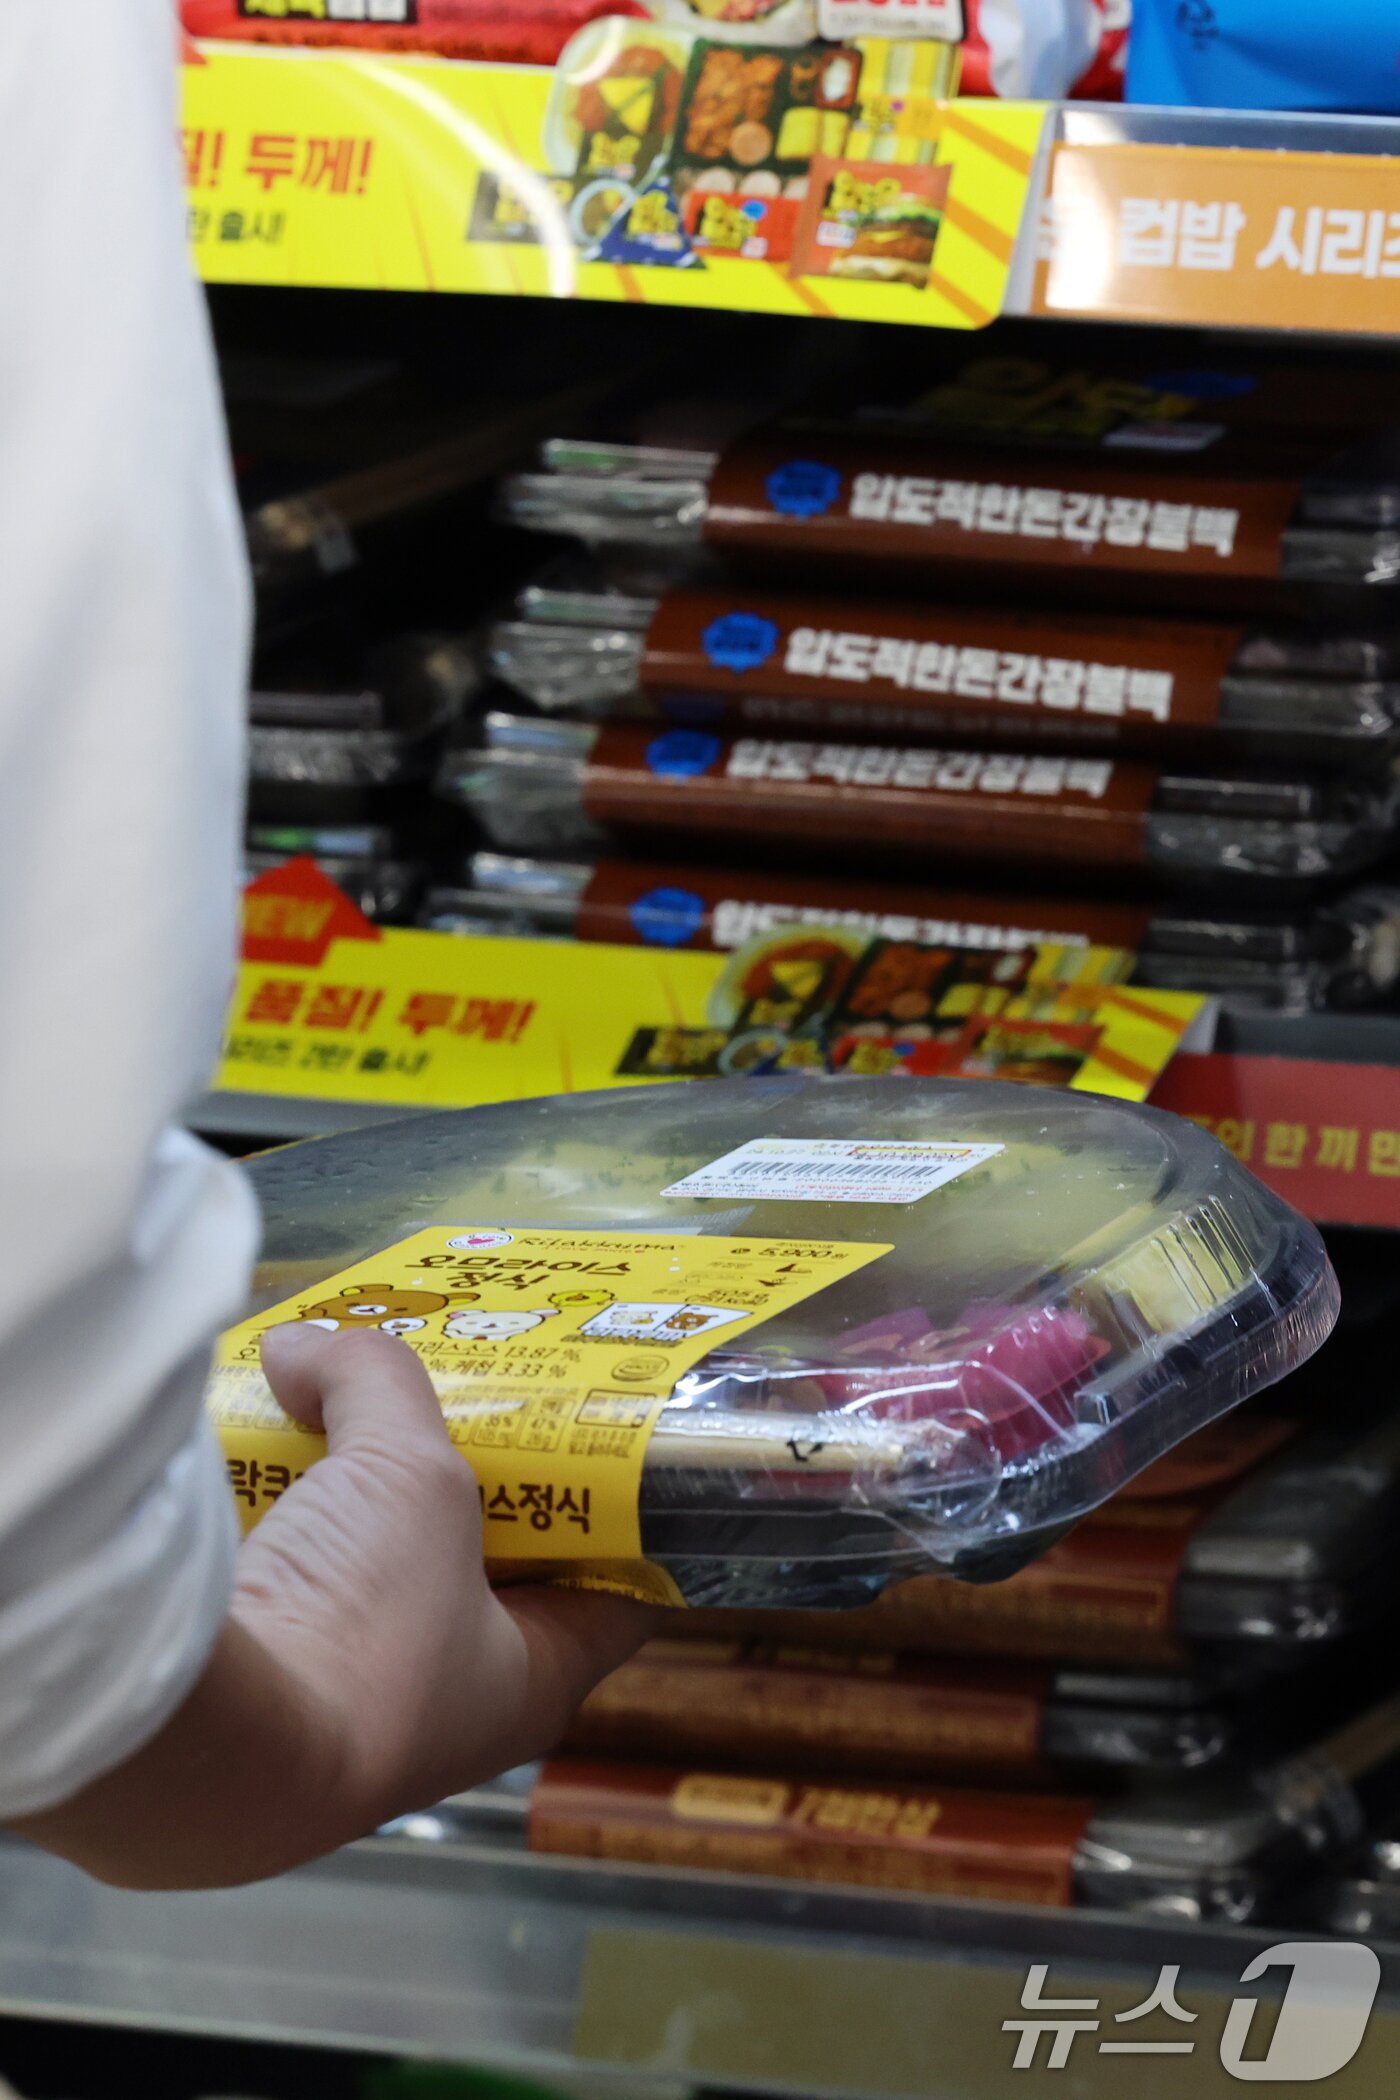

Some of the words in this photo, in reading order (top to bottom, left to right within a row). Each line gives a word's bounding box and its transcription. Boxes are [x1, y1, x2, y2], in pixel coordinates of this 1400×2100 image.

[246, 135, 373, 195] 두께!
[1120, 197, 1246, 271] 컵밥
[398, 991, 536, 1044] 두께!
[1264, 1121, 1308, 1168] 한
[1315, 1125, 1360, 1174] 끼
[405, 1255, 631, 1276] 오므라이스
[447, 1272, 550, 1290] 정식
